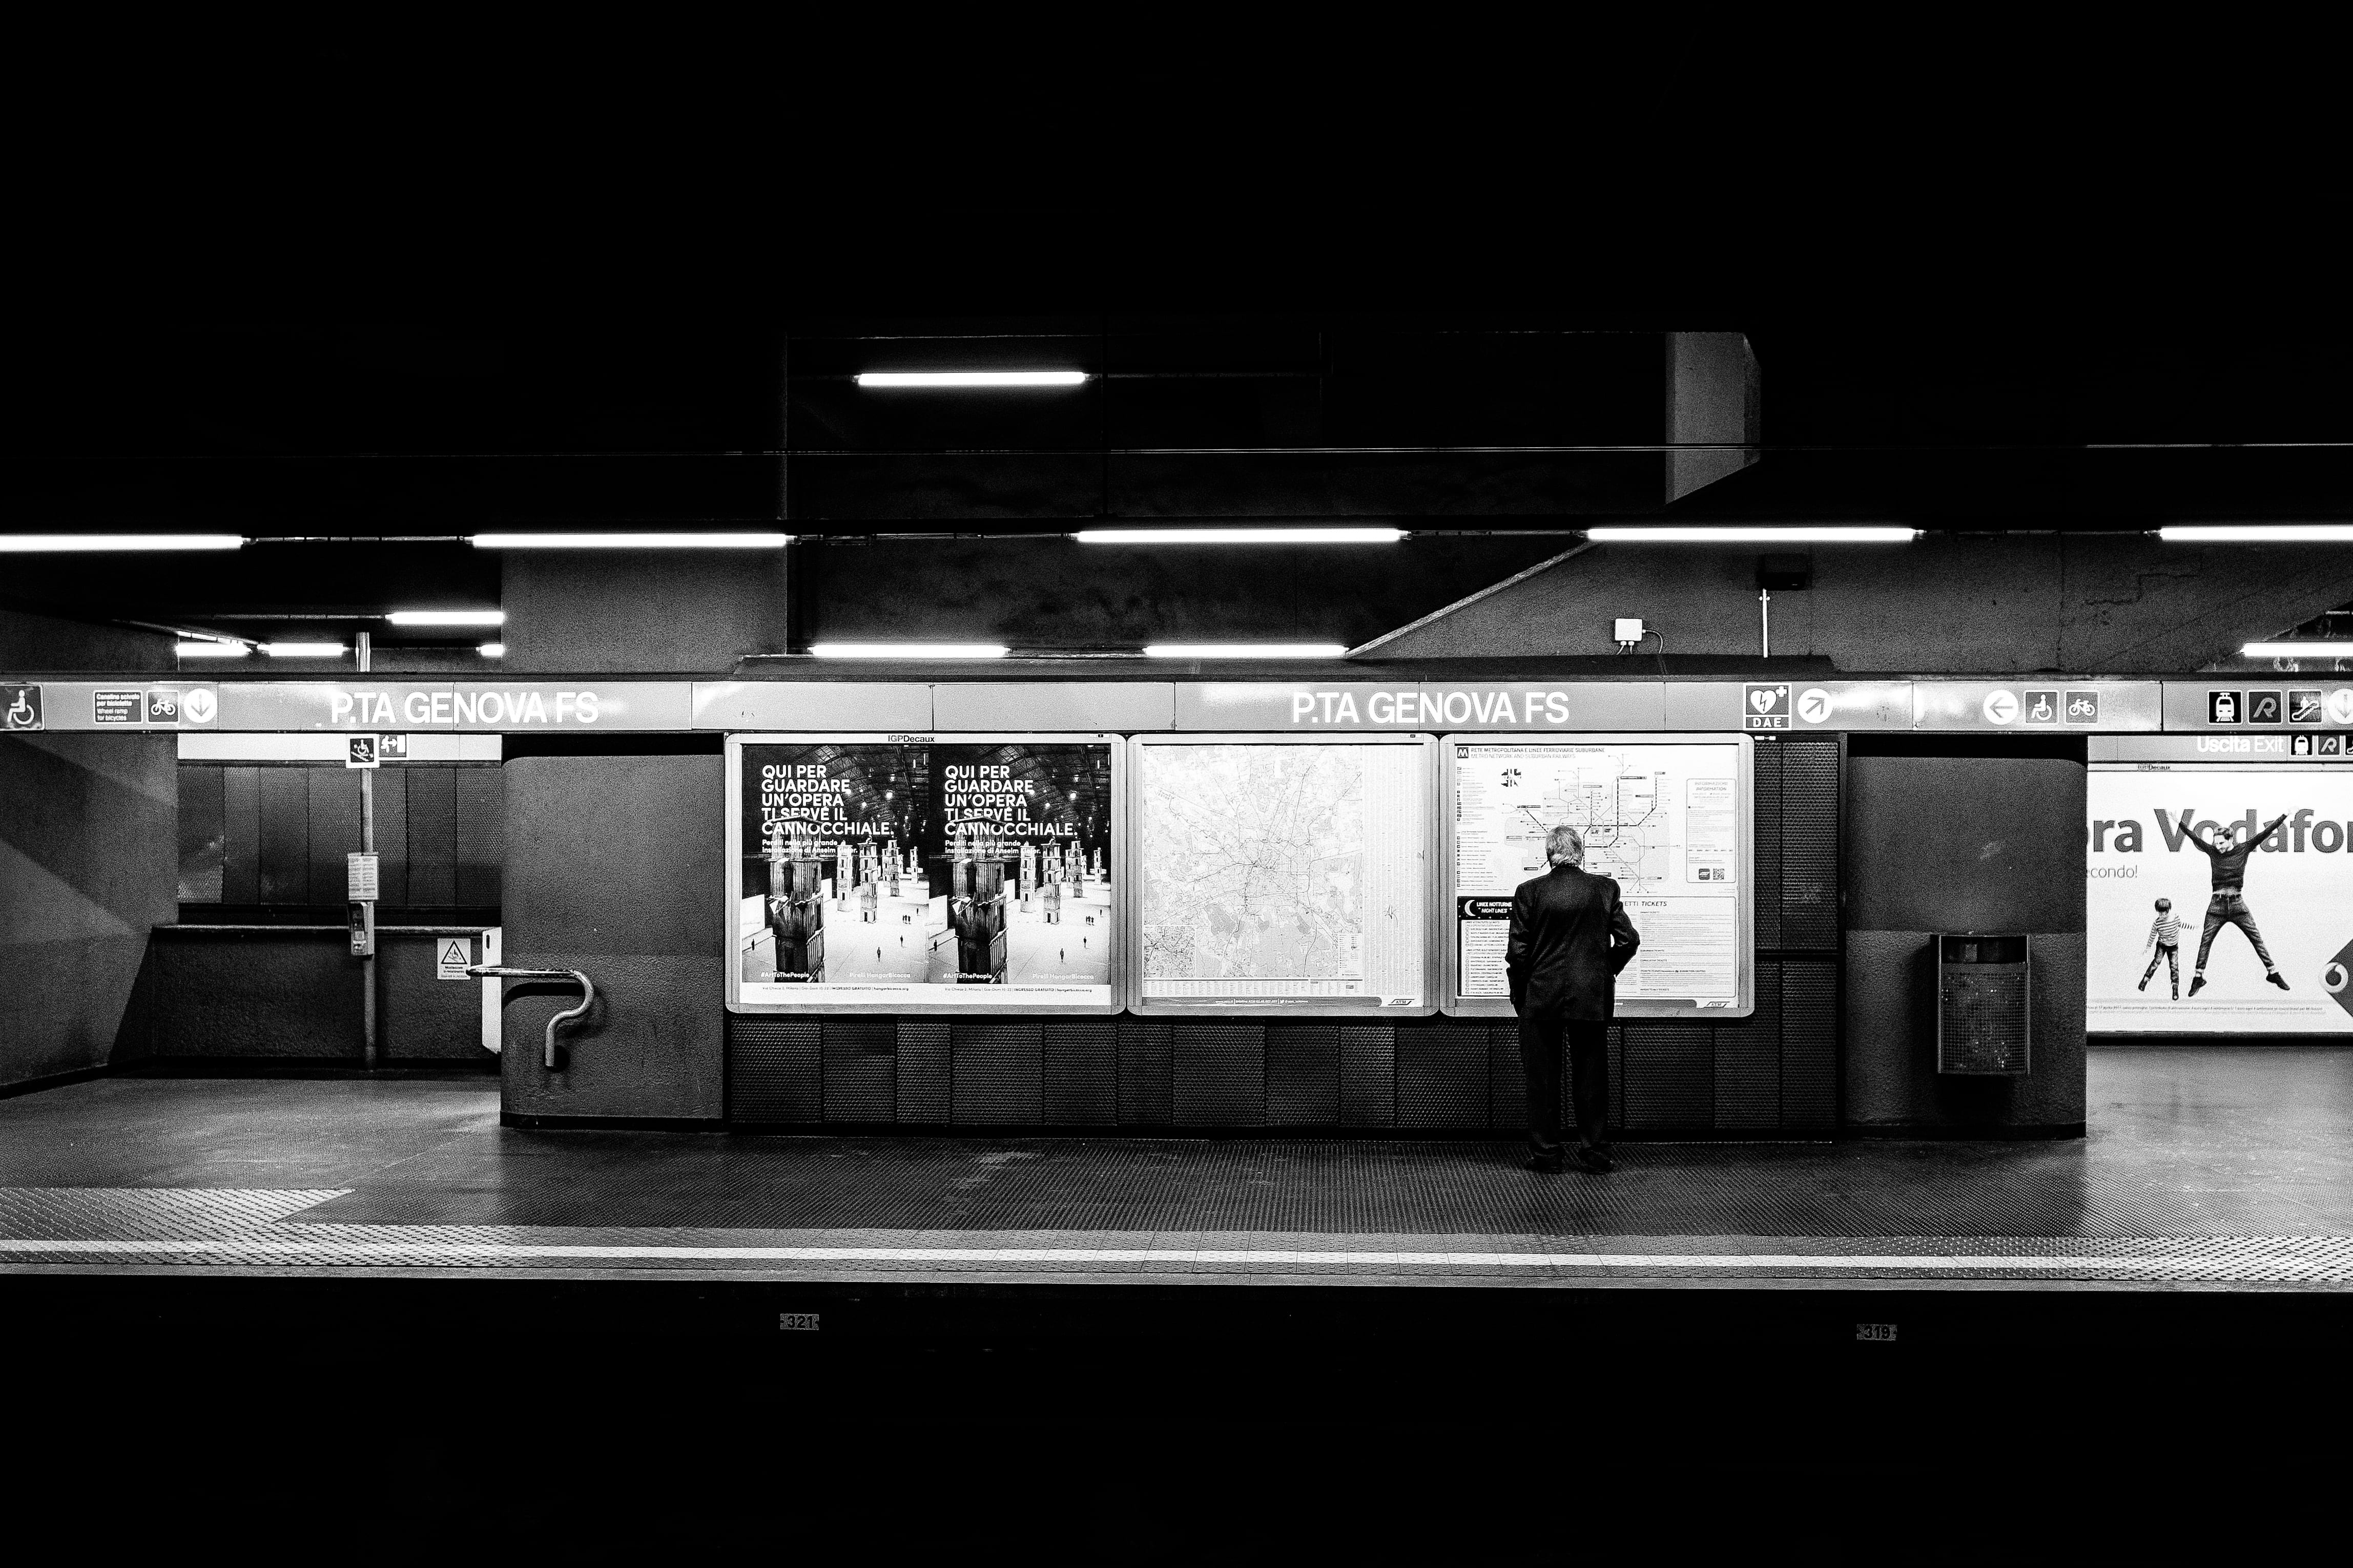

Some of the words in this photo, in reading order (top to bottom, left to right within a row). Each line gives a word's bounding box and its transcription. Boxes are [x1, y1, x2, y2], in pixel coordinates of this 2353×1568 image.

[331, 692, 397, 723] P.TA
[404, 691, 548, 724] GENOVA
[555, 691, 598, 724] FS
[1293, 692, 1360, 724] P.TA
[1368, 691, 1517, 724] GENOVA
[1525, 691, 1570, 724] FS
[1752, 717, 1782, 727] DAE
[2197, 735, 2251, 753] Uscita
[2255, 735, 2285, 753] Exit
[762, 764, 791, 780] QUI
[797, 765, 827, 778] PER
[945, 765, 975, 780] QUI
[980, 765, 1010, 779] PER
[761, 779, 851, 792] GUARDARE
[944, 779, 1034, 793] GUARDARE
[761, 807, 776, 821] TI
[780, 807, 830, 821] SERVE
[834, 807, 848, 821] IL
[944, 808, 958, 821] TI
[963, 808, 1013, 821] SERVE
[1018, 808, 1031, 821] IL
[761, 822, 894, 835] CANNOCCHIALE.
[944, 822, 1078, 836] CANNOCCHIALE.
[2086, 820, 2143, 853] ra
[2153, 808, 2353, 853] Vodafo
[787, 1315, 814, 1328] 321
[1864, 1325, 1891, 1339] 319
